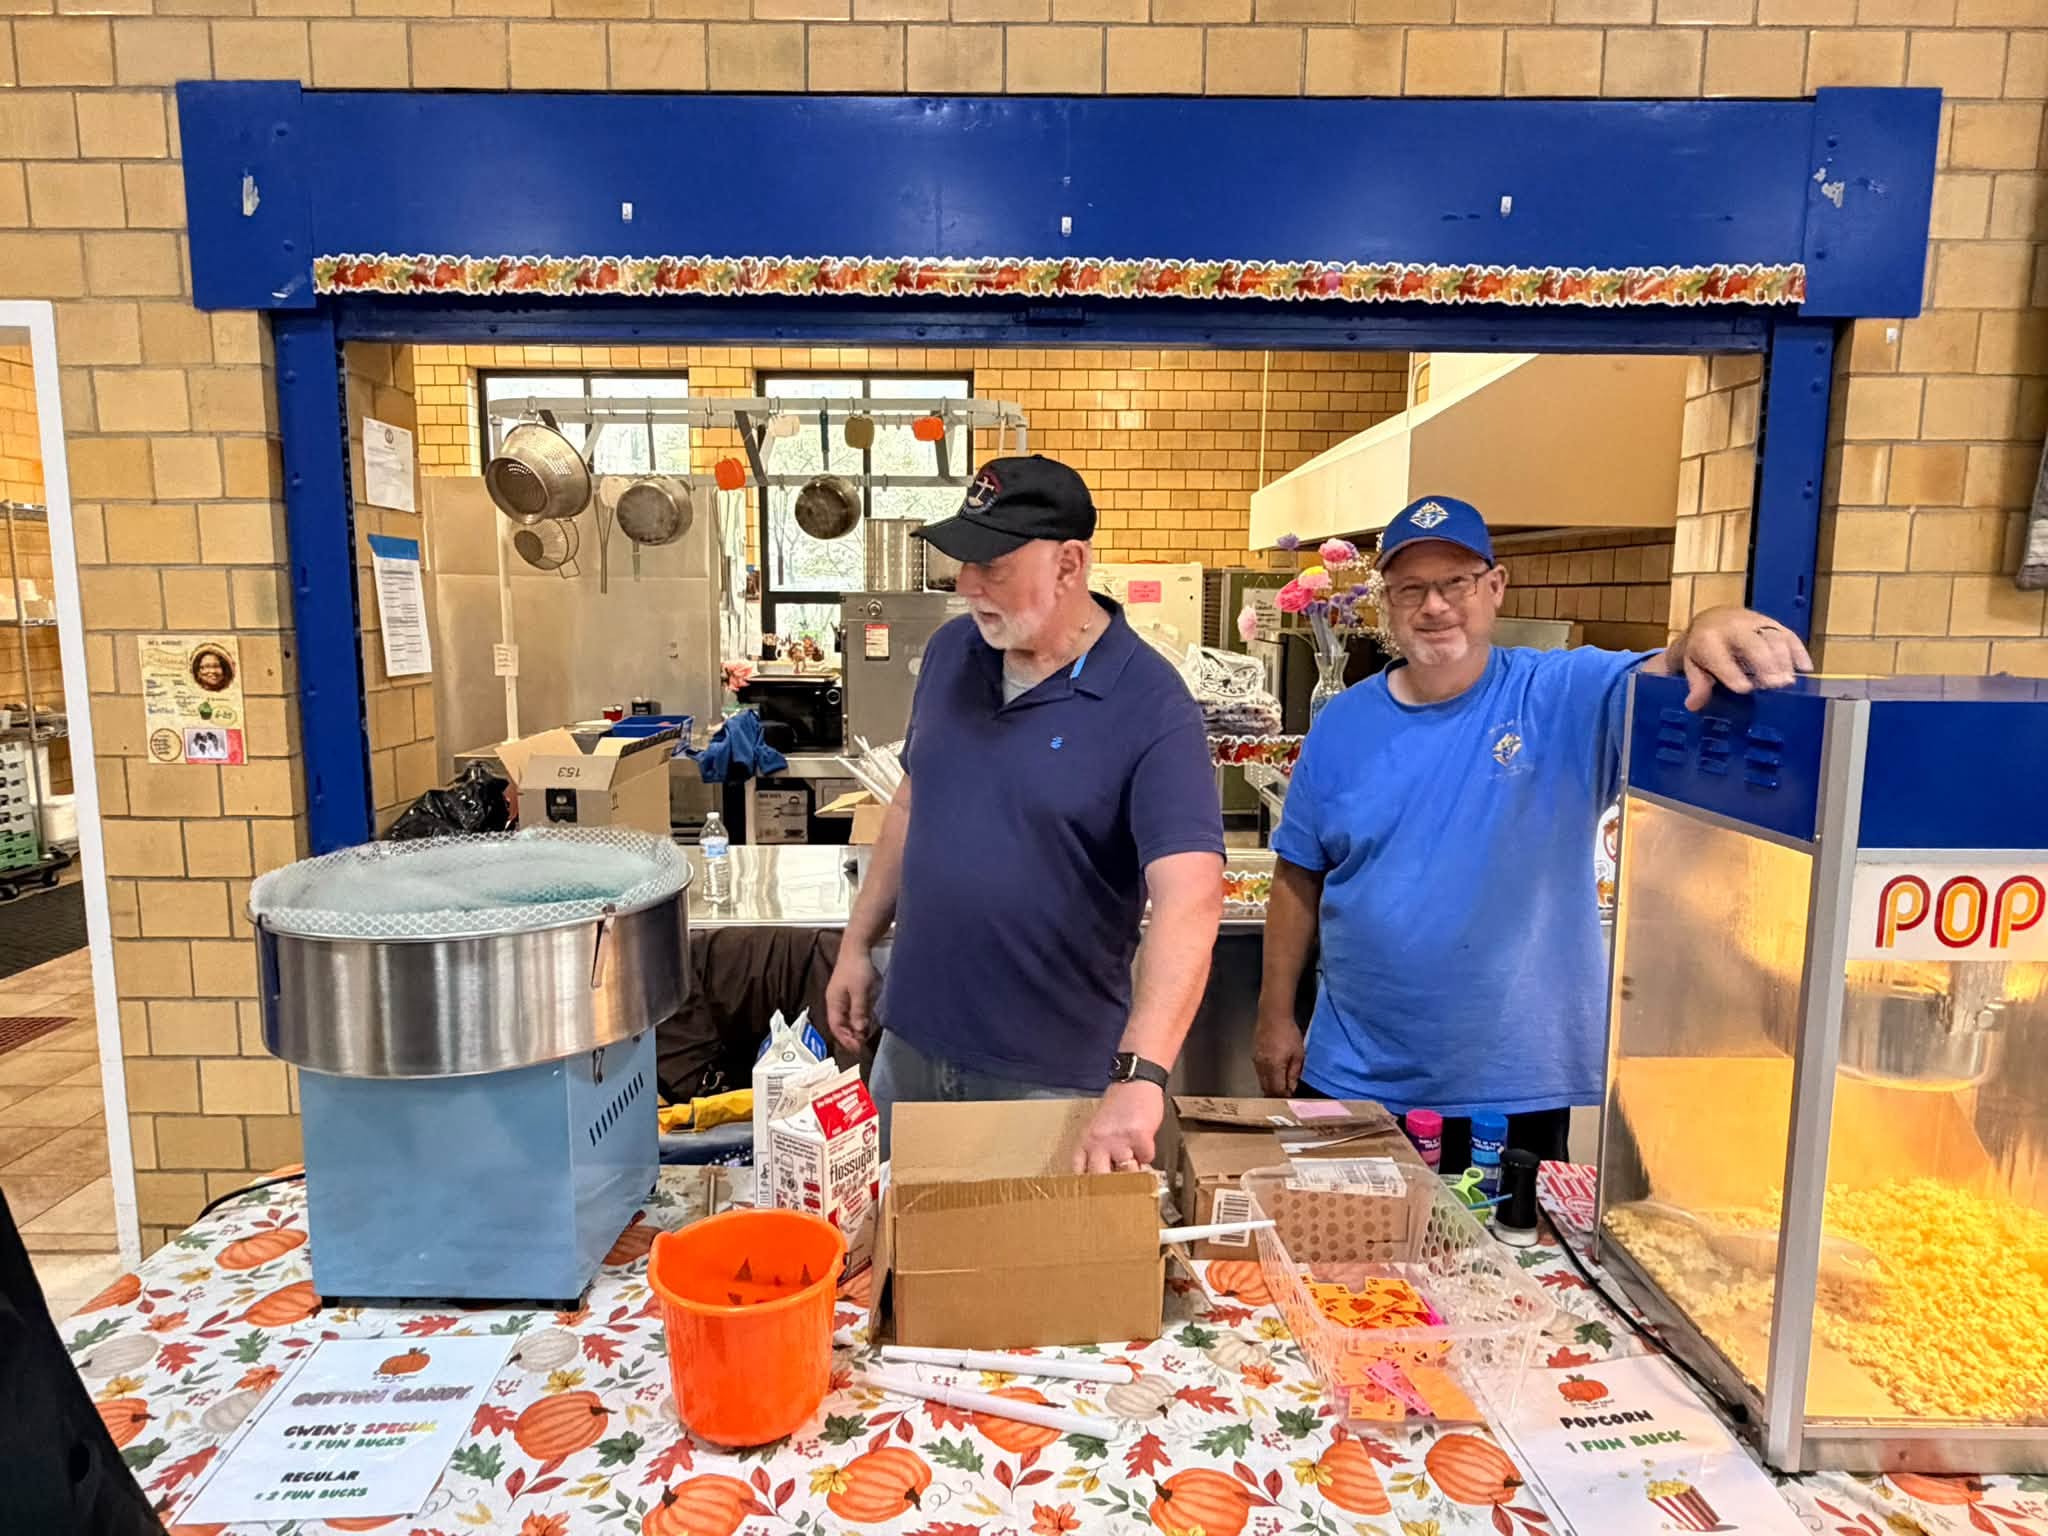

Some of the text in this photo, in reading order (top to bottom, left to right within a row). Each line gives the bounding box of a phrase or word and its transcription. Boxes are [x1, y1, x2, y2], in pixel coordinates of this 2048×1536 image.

[557, 767, 582, 778] 153
[1875, 874, 2047, 949] POP
[829, 1146, 876, 1184] flossugar
[292, 1384, 475, 1407] COTTON CANDY
[283, 1420, 438, 1438] GWEN'S SPECIAL
[1559, 1409, 1655, 1430] POPCORN
[314, 1438, 351, 1450] FUN
[354, 1436, 408, 1448] BUCKS
[1580, 1437, 1627, 1453] FUN
[1629, 1429, 1689, 1447] BUCK
[279, 1470, 361, 1484] REGULAR
[281, 1489, 315, 1501] FUN
[317, 1487, 369, 1499] BUCKS
